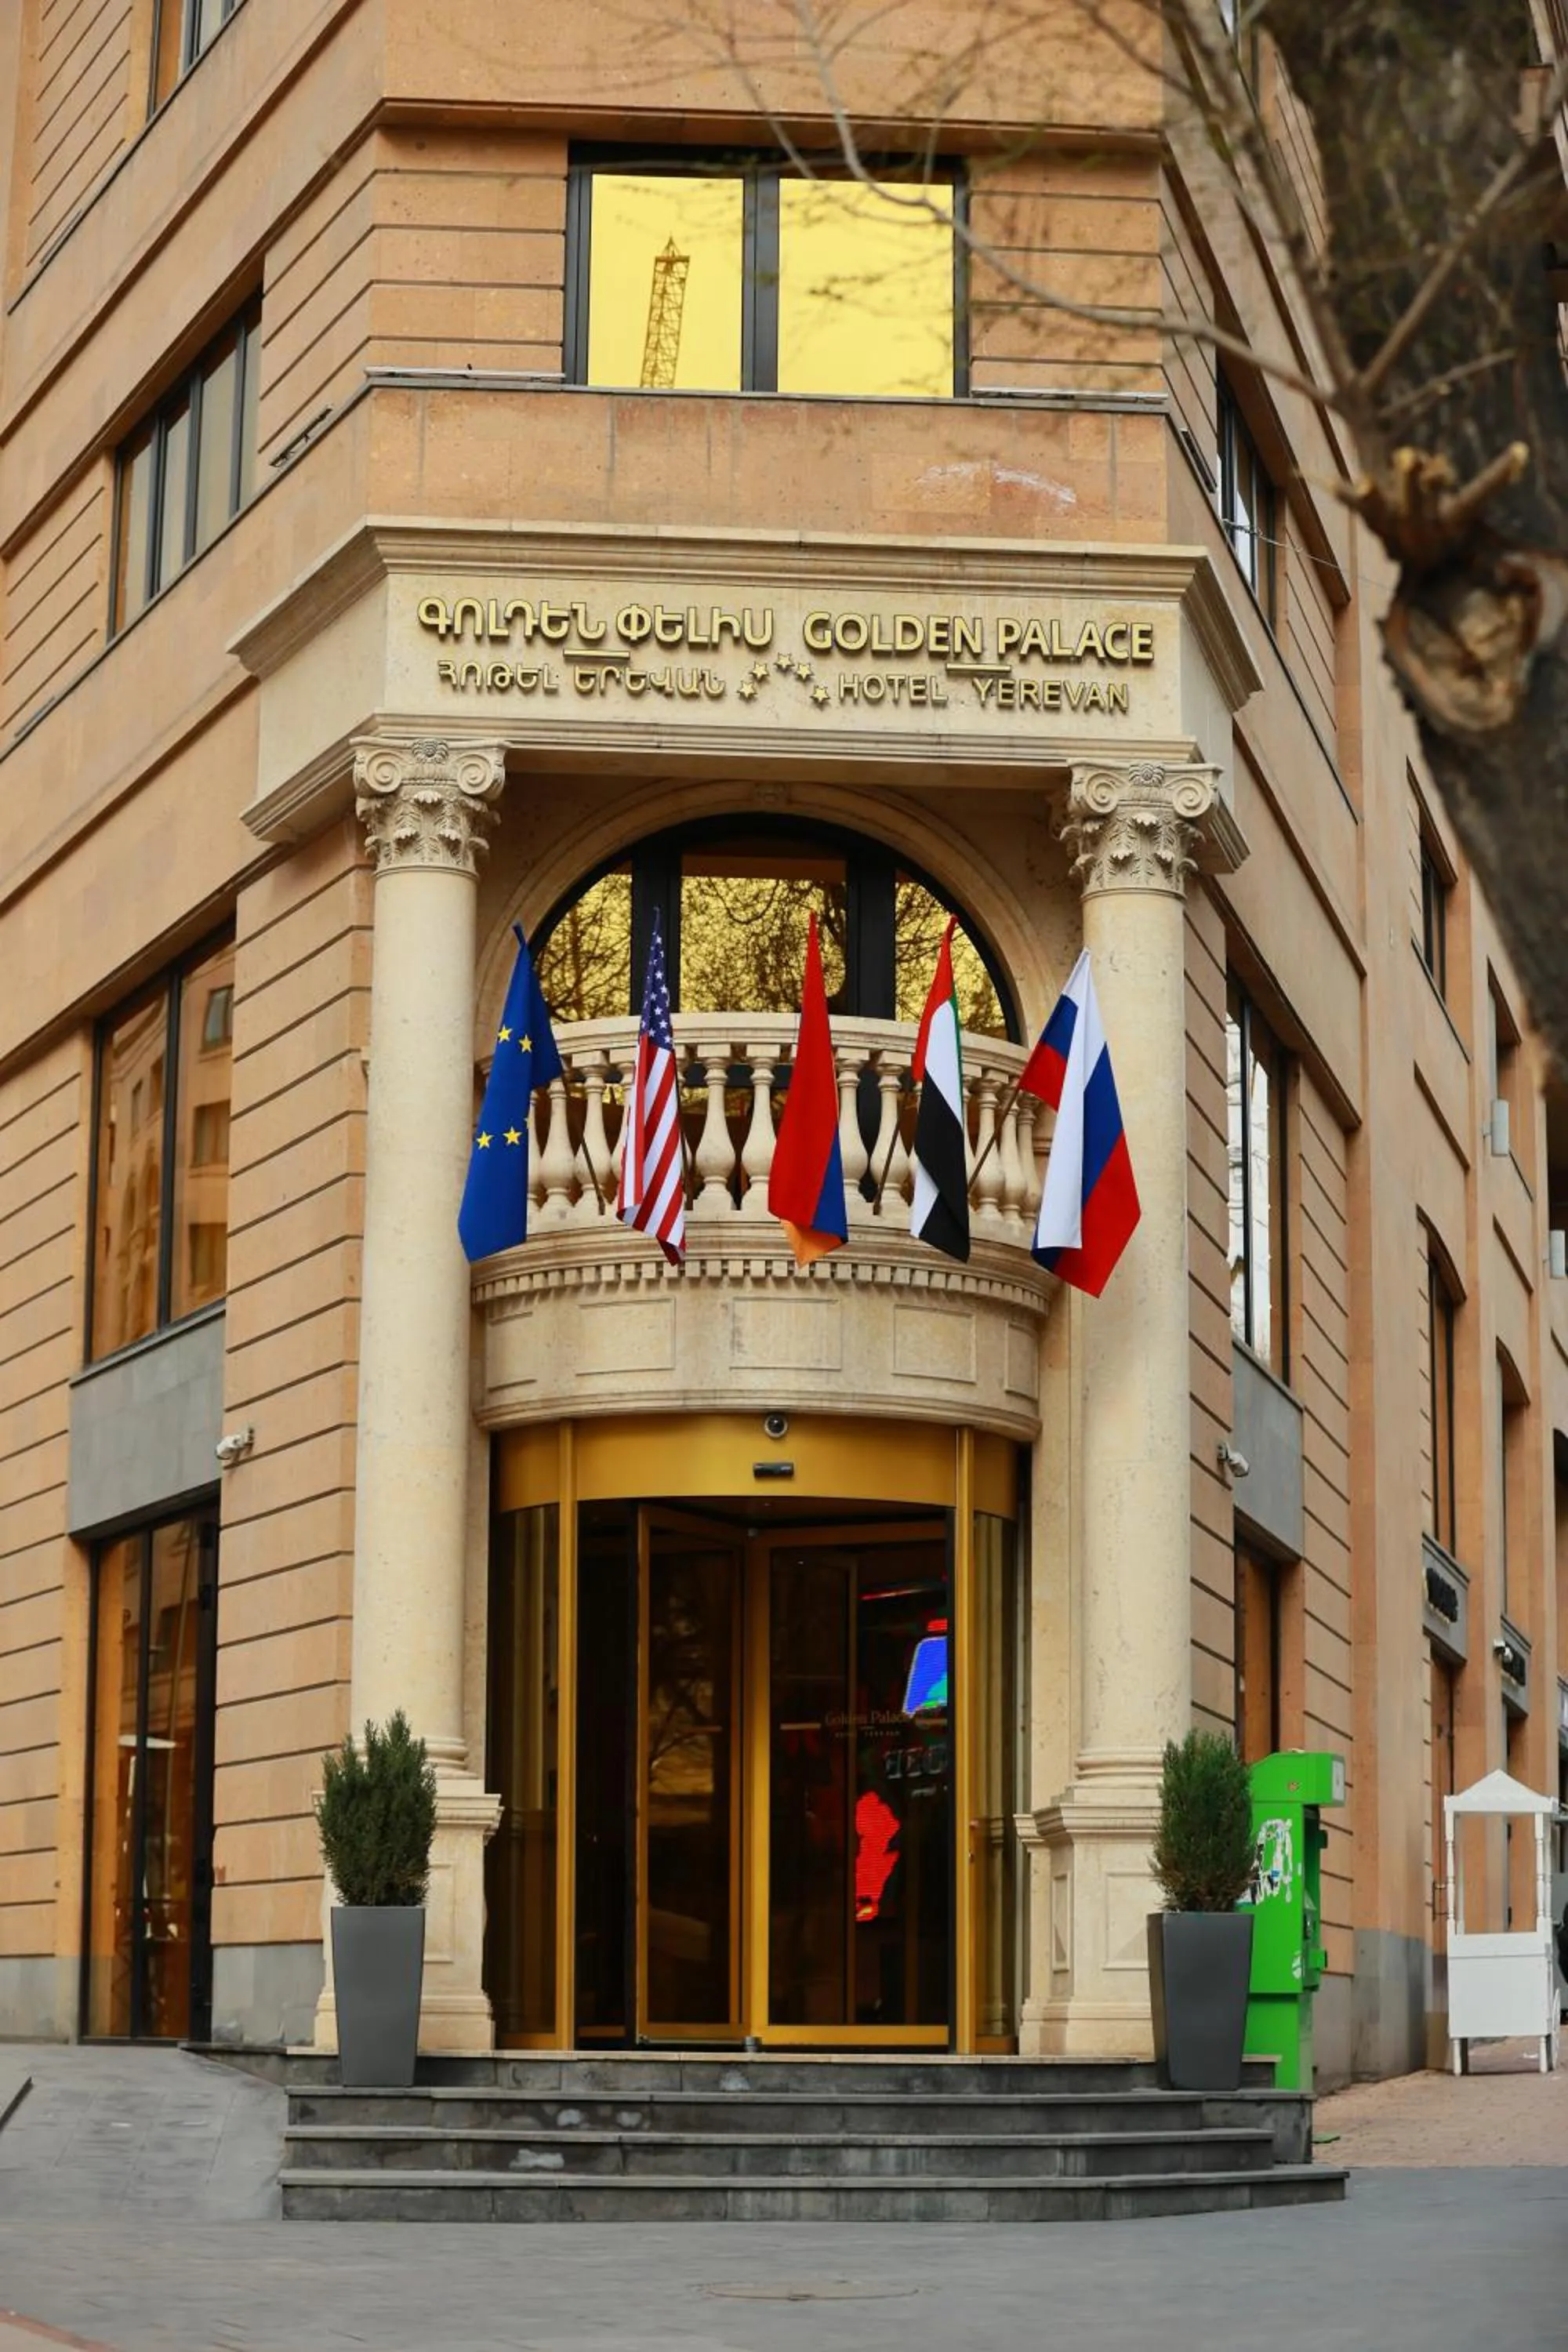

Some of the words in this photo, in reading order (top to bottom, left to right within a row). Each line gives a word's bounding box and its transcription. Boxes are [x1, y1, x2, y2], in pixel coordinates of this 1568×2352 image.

[418, 597, 606, 641] ԳՈԼԴԵՆ
[616, 604, 773, 647] ՓԵԼԻՍ
[803, 612, 982, 655] GOLDEN
[996, 617, 1155, 661] PALACE
[437, 660, 559, 693] ՀՈԹԵԼ
[574, 666, 726, 697] ԵՐԵՎԱՆ
[839, 673, 948, 702] HOTEL
[971, 677, 1129, 710] YEREVAN
